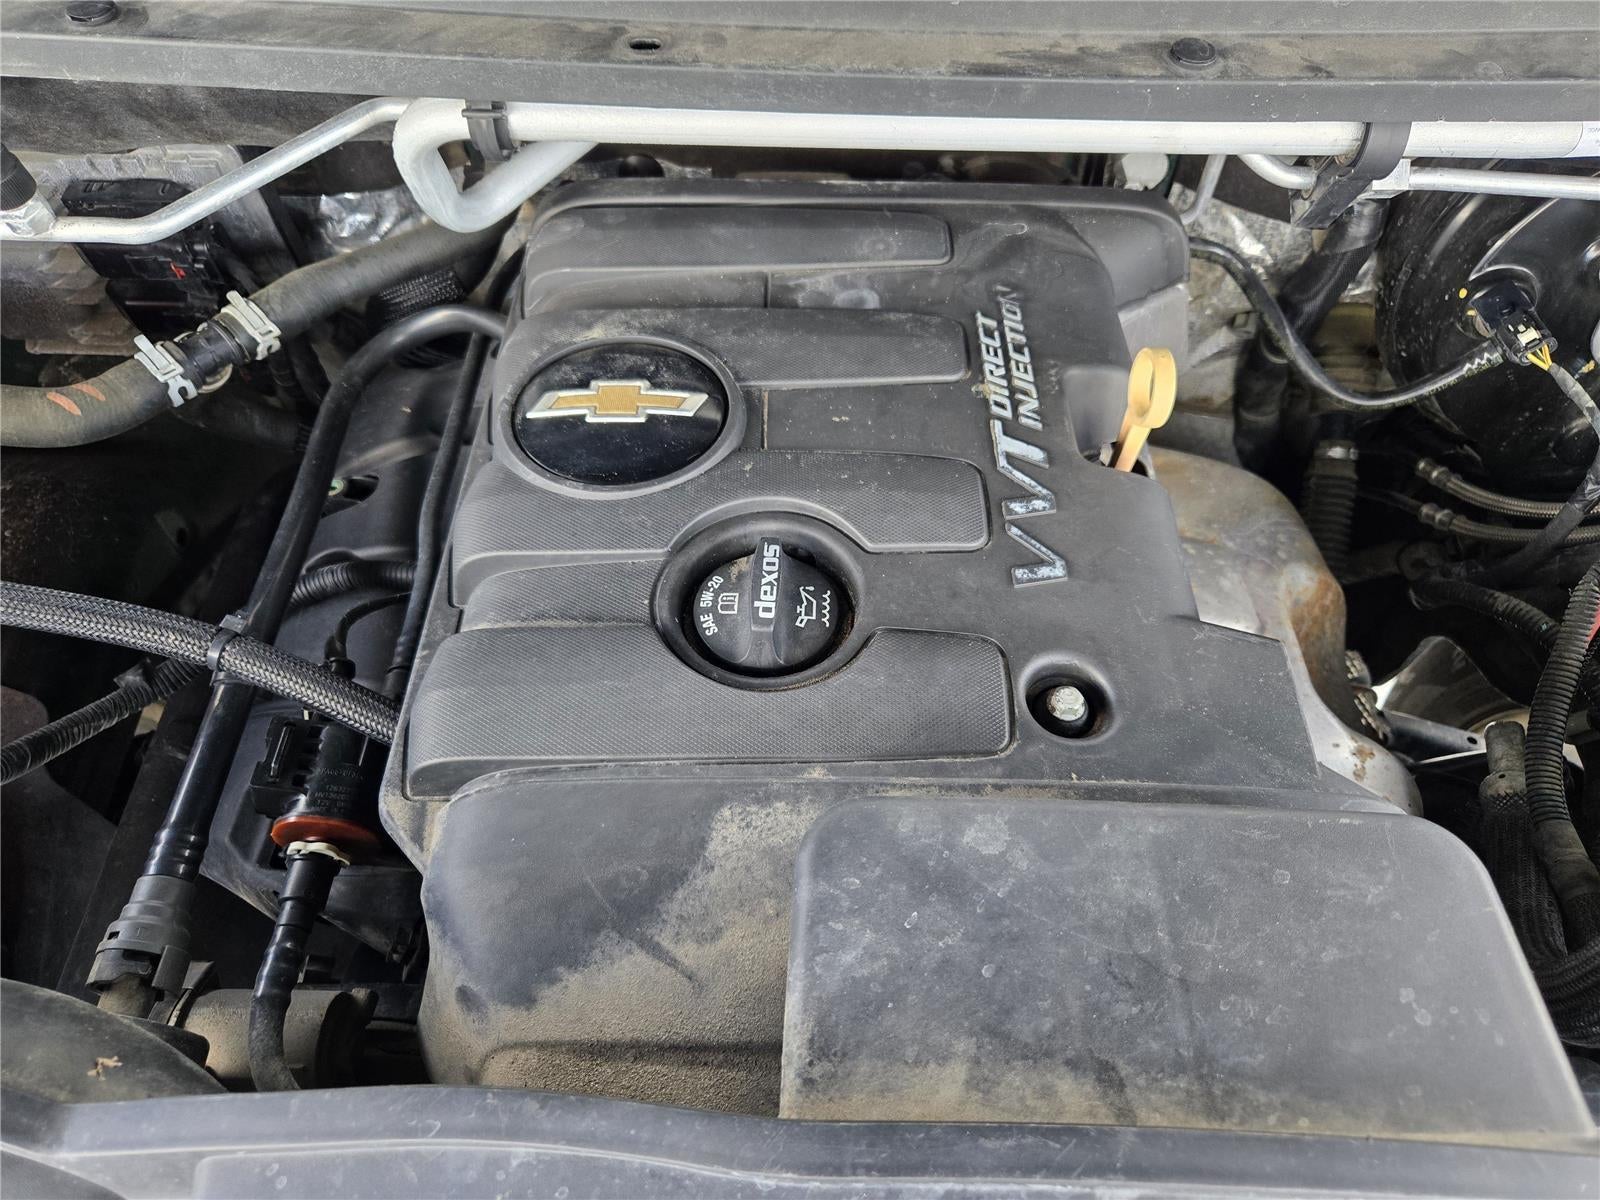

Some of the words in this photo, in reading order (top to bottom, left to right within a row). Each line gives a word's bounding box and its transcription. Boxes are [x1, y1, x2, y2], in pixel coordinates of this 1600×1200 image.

[976, 310, 1013, 420] DIRECT
[996, 285, 1043, 431] INJECTION
[990, 418, 1068, 588] VVT
[700, 575, 724, 607] 5W-20
[700, 613, 718, 636] SAE
[753, 542, 780, 619] dexos
